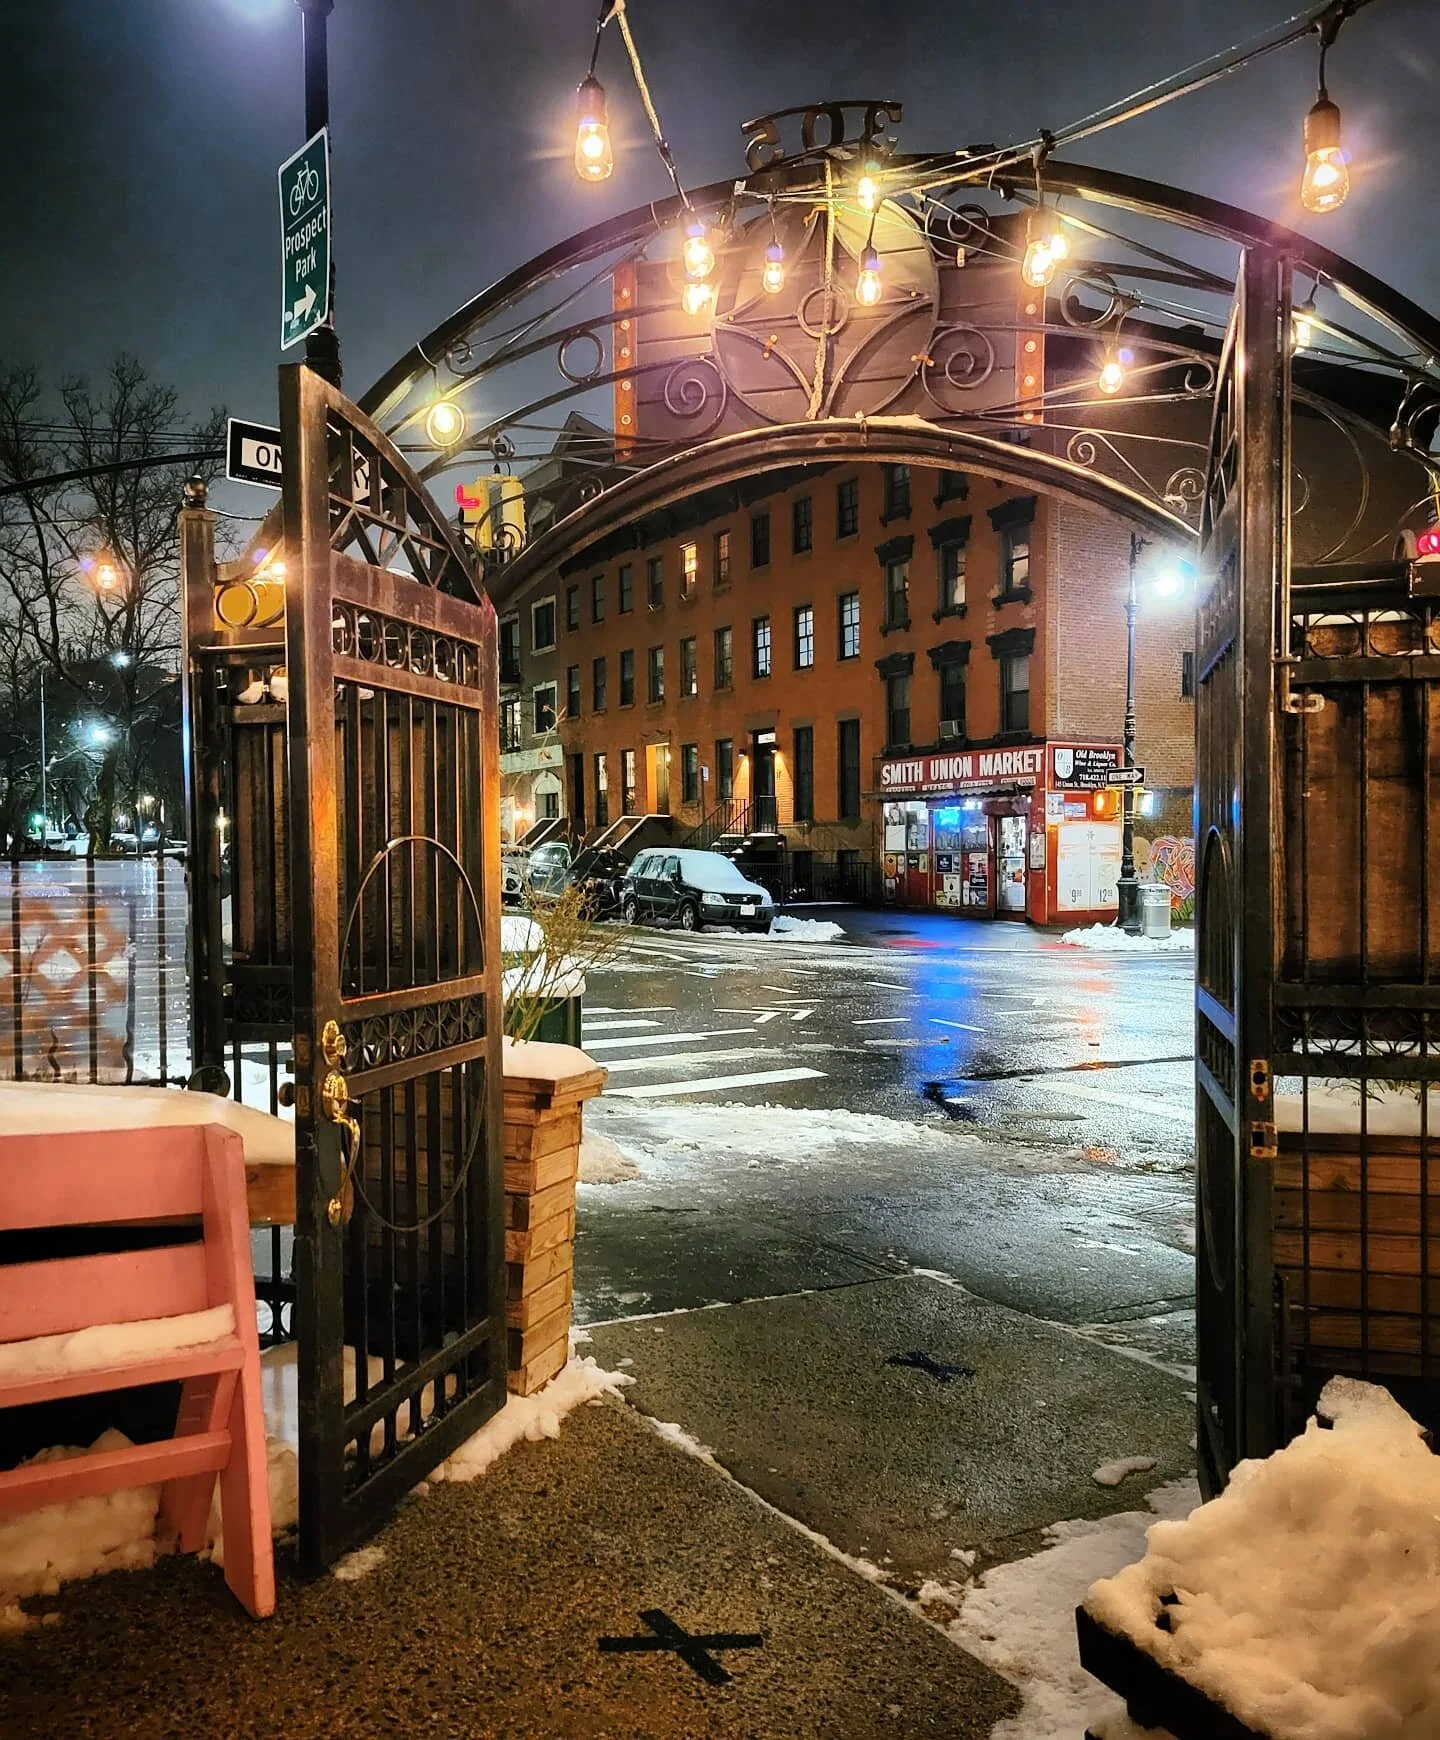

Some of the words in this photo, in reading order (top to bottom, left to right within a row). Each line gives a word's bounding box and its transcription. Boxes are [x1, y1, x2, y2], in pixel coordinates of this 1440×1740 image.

[285, 205, 327, 260] Prospect
[295, 246, 317, 283] Park
[255, 445, 282, 470] ON
[882, 760, 924, 785] SMITH
[930, 755, 972, 781] UNION
[979, 749, 1044, 777] MARKET
[1075, 750, 1088, 759] Old
[1089, 751, 1116, 761] Brooklyn
